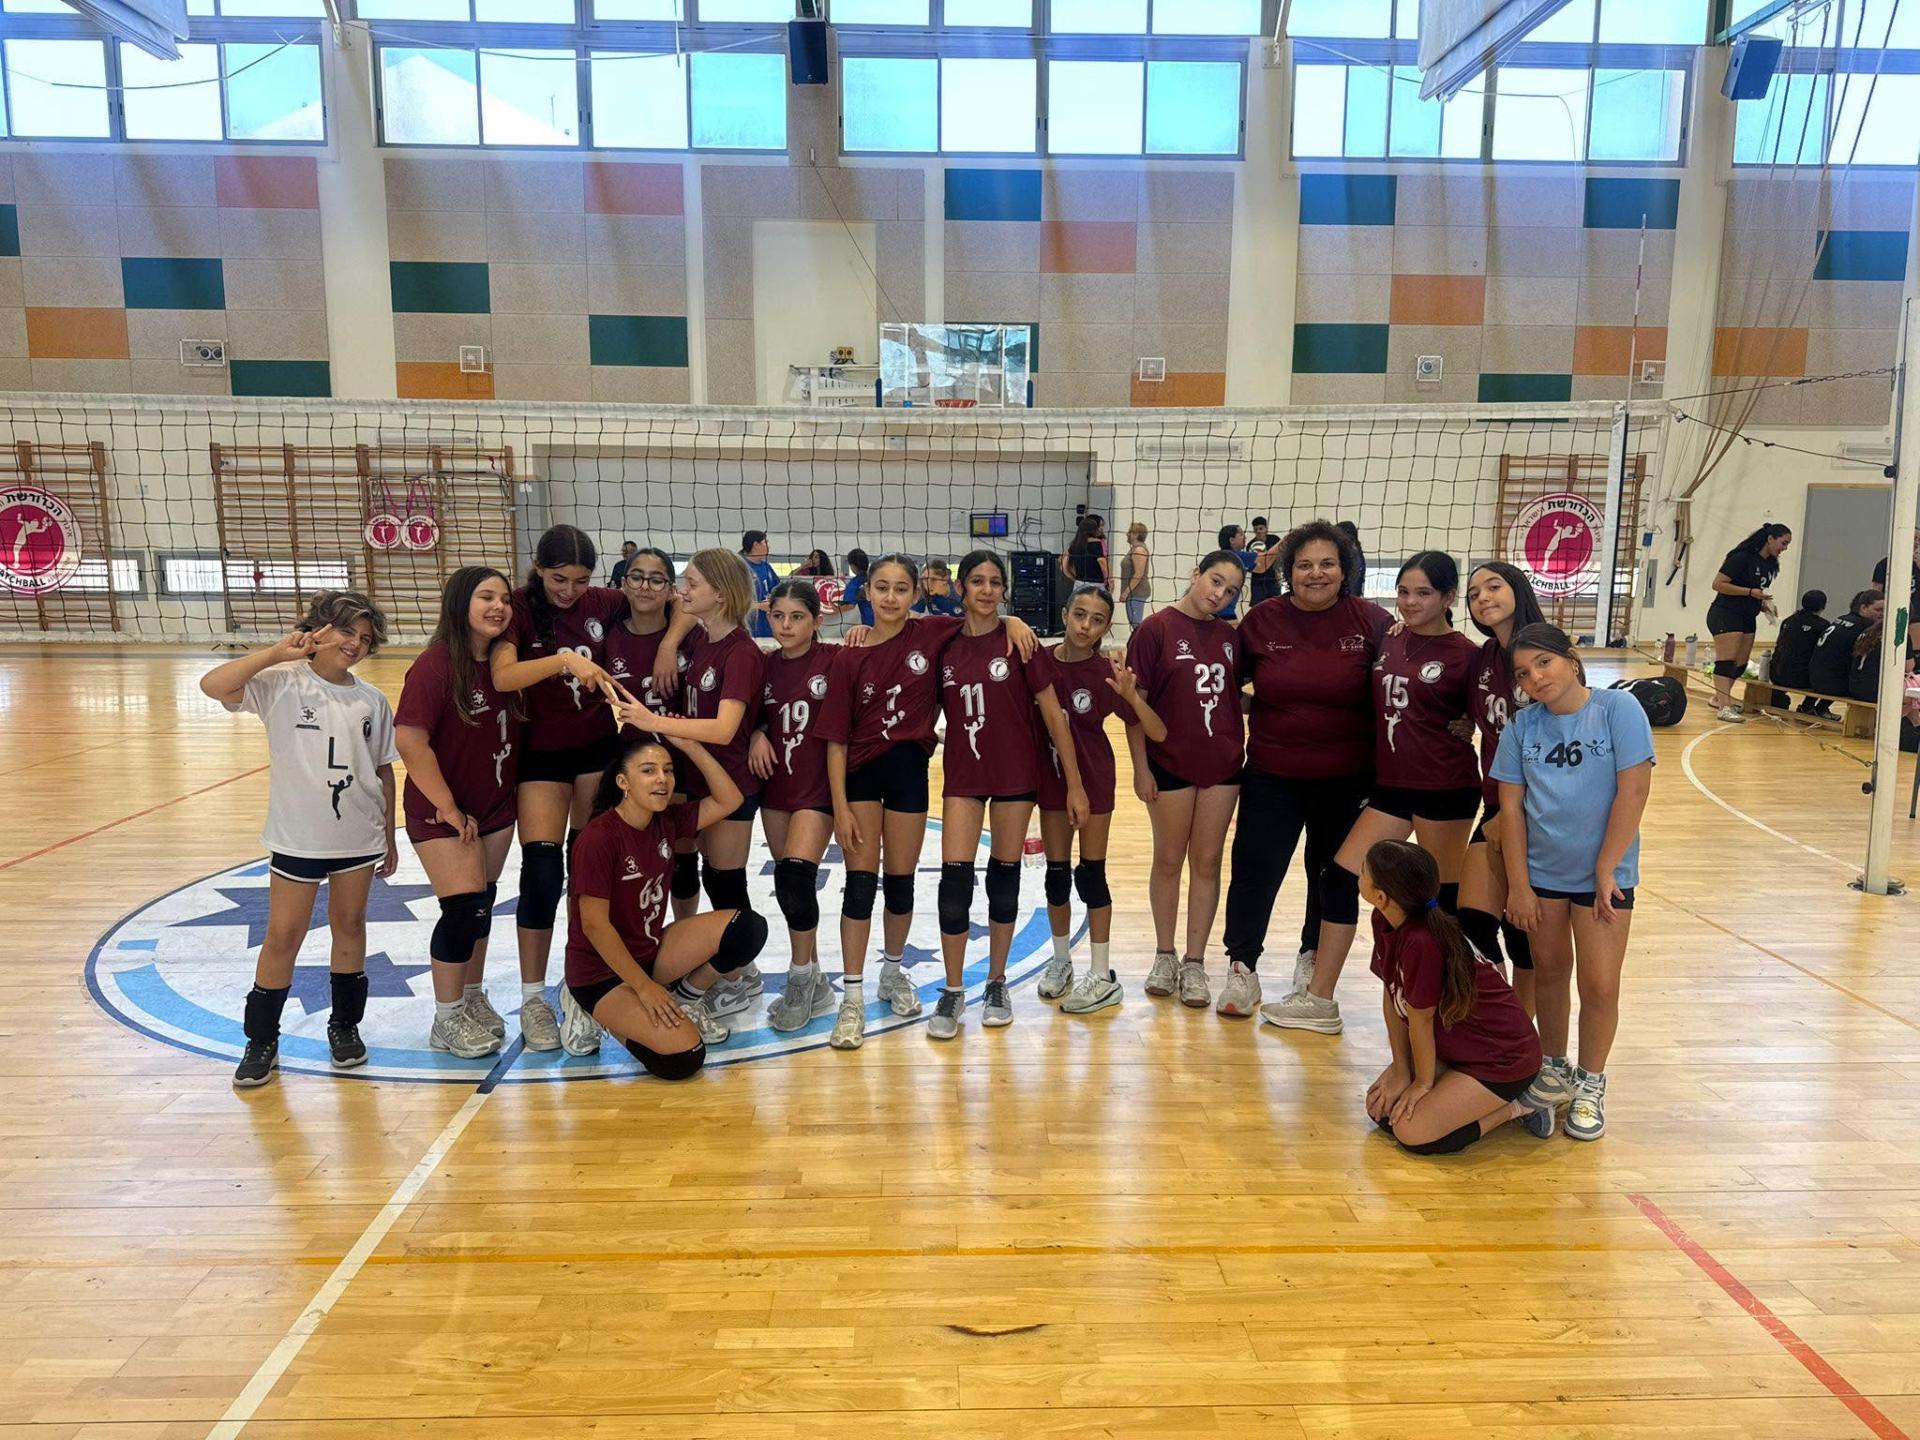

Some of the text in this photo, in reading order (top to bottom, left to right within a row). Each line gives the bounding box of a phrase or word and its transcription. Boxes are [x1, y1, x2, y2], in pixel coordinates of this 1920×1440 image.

[6, 492, 63, 517] הכדורשת
[1547, 499, 1596, 523] הכדורשת
[0, 568, 46, 587] ATCHBALL
[1816, 624, 1836, 647] 3
[1194, 663, 1226, 694] 23
[1382, 673, 1409, 709] 15
[886, 684, 902, 712] 7
[960, 683, 986, 717] 11
[779, 700, 810, 734] 19
[328, 737, 348, 769] L
[1544, 740, 1583, 768] 46
[640, 872, 664, 910] 63
